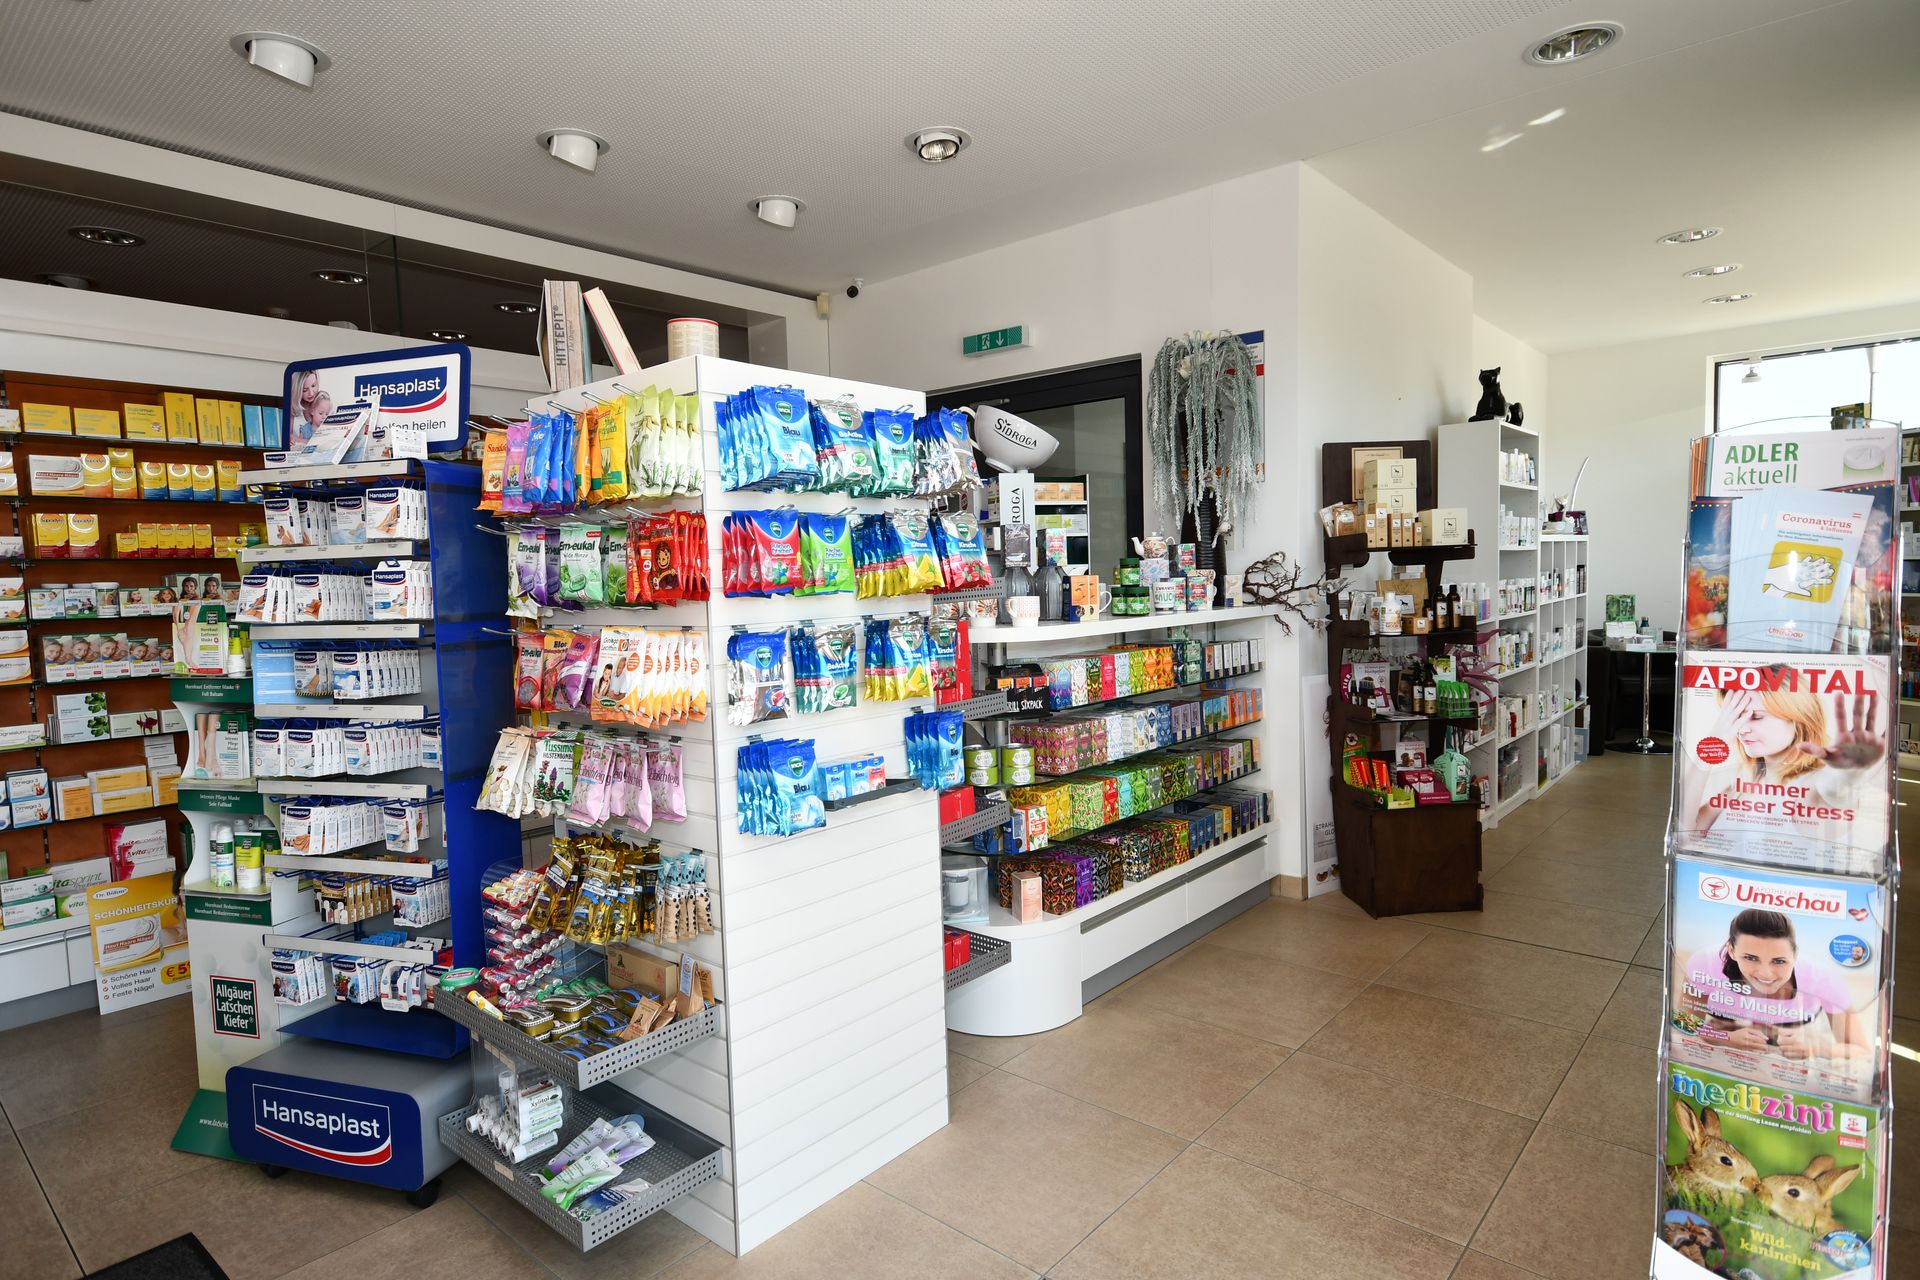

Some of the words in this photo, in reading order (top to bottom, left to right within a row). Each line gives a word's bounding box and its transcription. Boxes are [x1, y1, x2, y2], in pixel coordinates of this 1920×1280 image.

[554, 311, 567, 366] HITTEPIT
[360, 376, 441, 397] Hansaplast
[412, 419, 446, 431] heilen
[782, 425, 801, 437] Blau
[1724, 442, 1799, 465] ADLER
[1723, 464, 1797, 486] aktuell
[368, 491, 397, 499] Hansaplast
[1011, 487, 1021, 523] ROGA
[1782, 513, 1853, 529] Coronavirus
[560, 541, 596, 551] Em-eukal
[1694, 667, 1877, 697] APOVITAL
[1735, 777, 1810, 799] Immer
[1709, 794, 1776, 814] dieser
[1782, 800, 1855, 822] Stress
[1736, 883, 1840, 913] Umschau
[110, 970, 138, 983] Schöne
[139, 967, 156, 977] Haut
[166, 967, 176, 978] €
[1692, 969, 1752, 995] Fitness
[111, 980, 133, 990] Volles
[133, 976, 151, 985] Haar
[216, 984, 252, 1001] Allgäuer
[112, 989, 132, 999] Feste
[1682, 982, 1705, 999] für
[1709, 991, 1735, 1006] die
[1740, 996, 1815, 1021] Muskeln
[216, 999, 254, 1015] Latschen
[223, 1013, 250, 1029] Kiefer
[530, 1095, 550, 1108] Xylitol
[1671, 1072, 1835, 1133] medizini
[262, 1099, 381, 1139] Hansaplast
[1735, 1112, 1760, 1125] Stiftung
[1761, 1119, 1780, 1128] Lesen
[1750, 1229, 1792, 1249] Wild-
[1740, 1238, 1821, 1272] kaninchen
